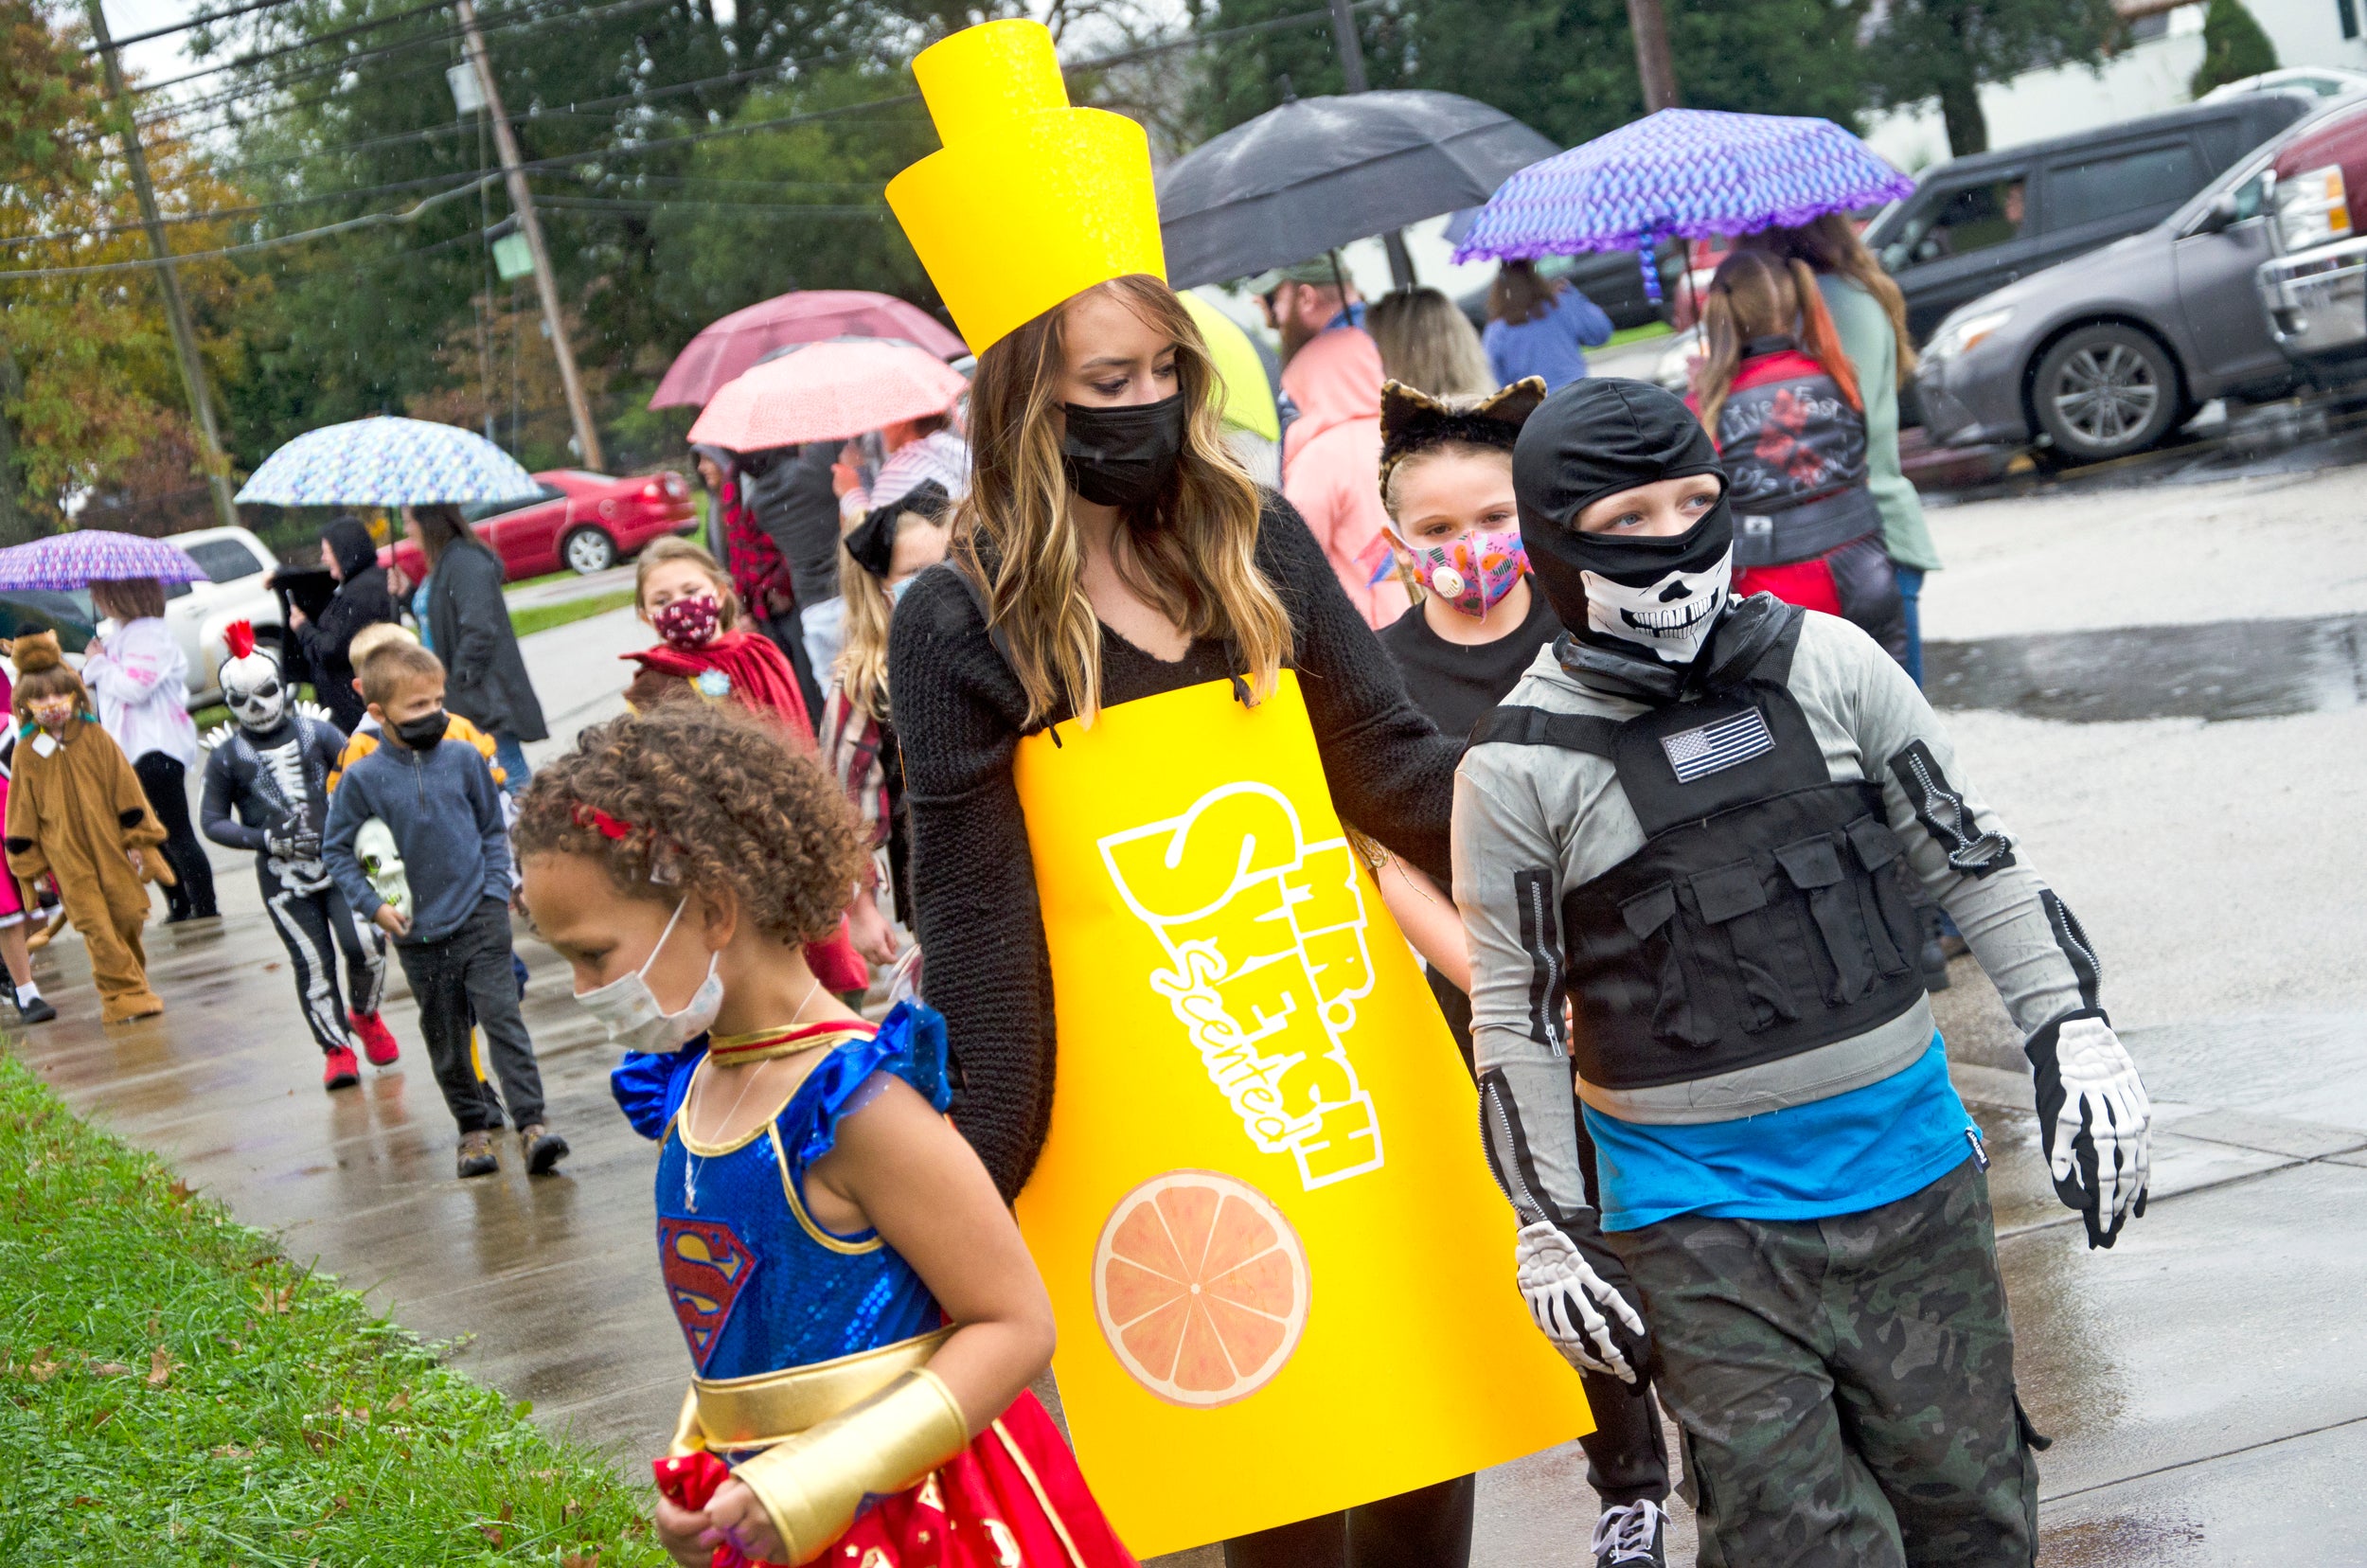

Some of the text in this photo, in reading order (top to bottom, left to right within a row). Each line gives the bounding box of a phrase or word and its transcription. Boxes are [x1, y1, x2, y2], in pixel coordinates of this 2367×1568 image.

[1096, 780, 1384, 1192] SKETCH
[1295, 837, 1375, 1033] MR.
[1149, 939, 1323, 1154] Scented
[662, 1218, 748, 1359] S
